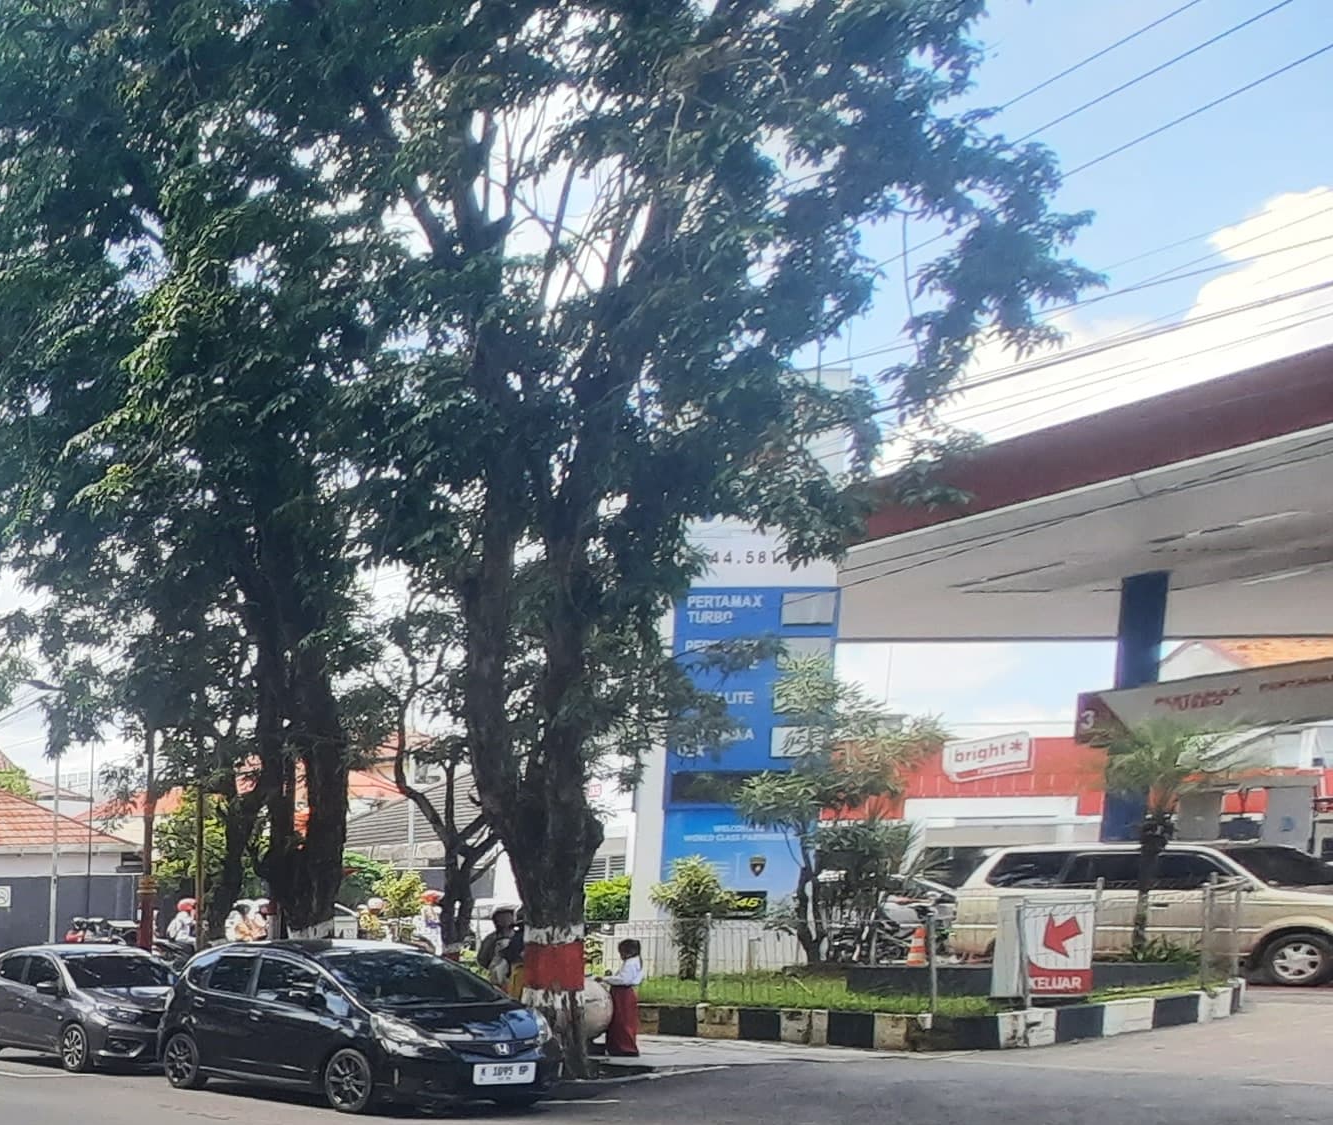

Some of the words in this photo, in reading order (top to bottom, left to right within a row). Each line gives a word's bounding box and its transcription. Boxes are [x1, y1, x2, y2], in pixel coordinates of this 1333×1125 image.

[686, 594, 763, 609] PERTAMAX
[688, 610, 733, 624] TURBO
[954, 743, 1007, 763] bright
